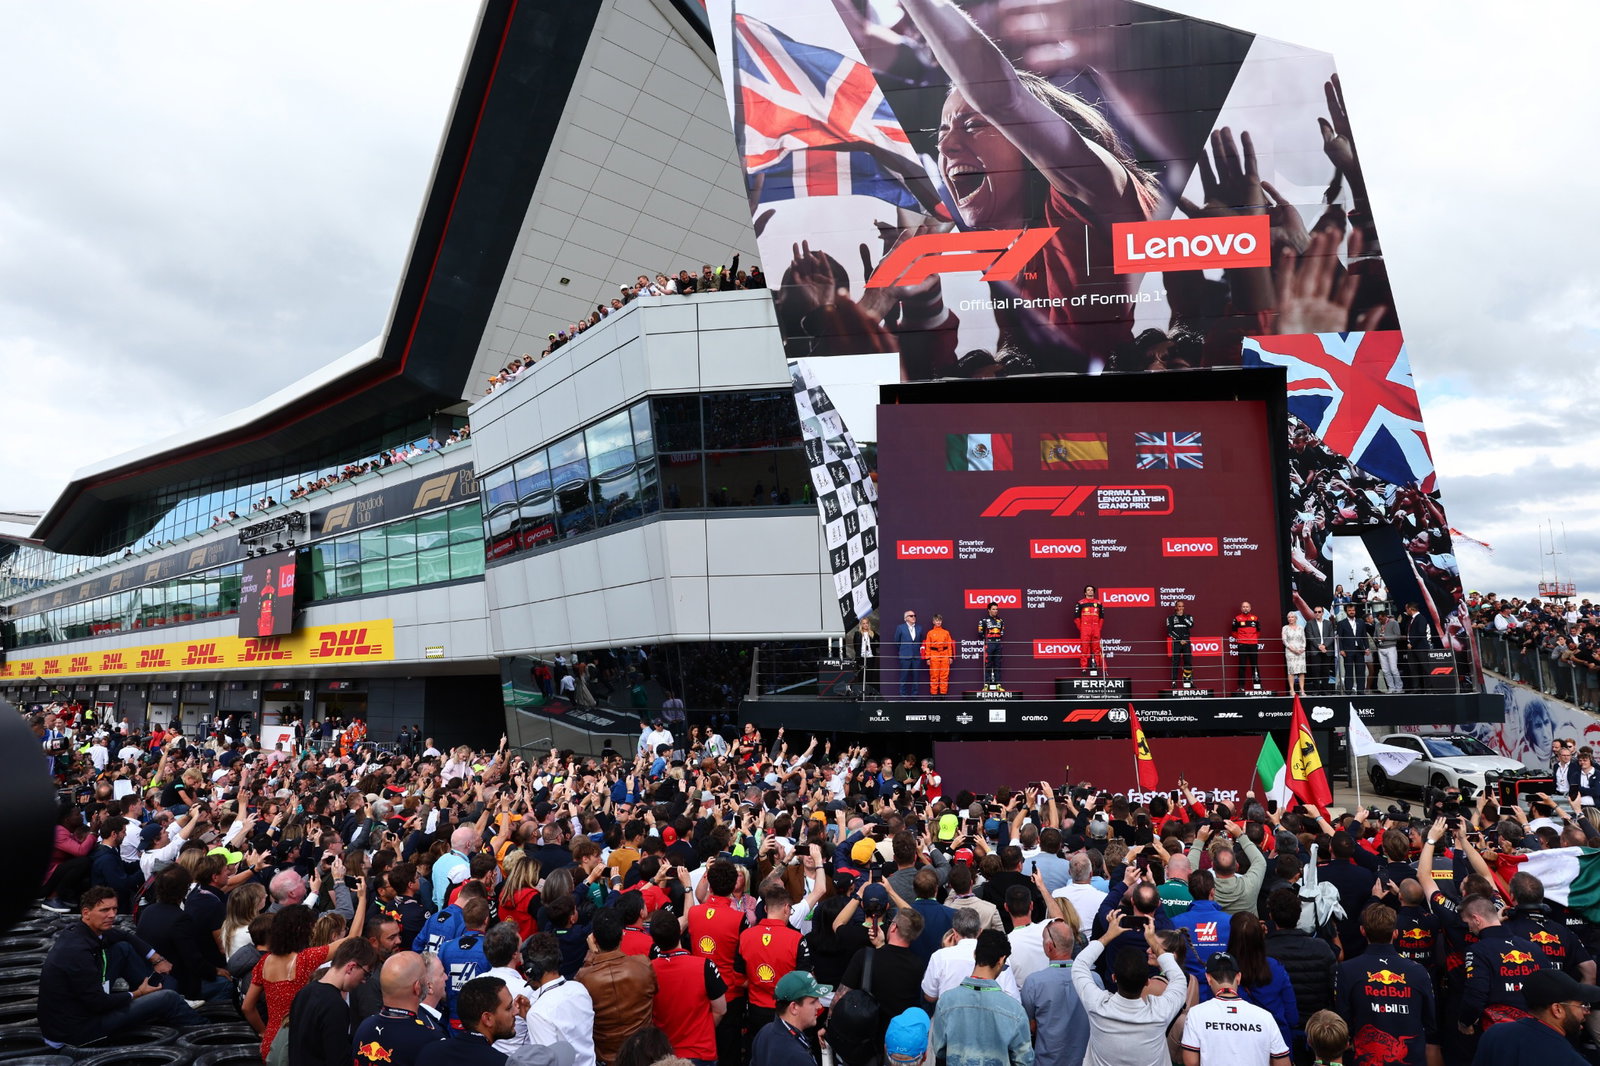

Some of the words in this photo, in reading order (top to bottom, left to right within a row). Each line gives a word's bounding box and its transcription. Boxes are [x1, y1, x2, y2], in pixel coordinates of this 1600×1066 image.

[1126, 232, 1257, 261] Lenovo
[960, 298, 1009, 311] Official
[1013, 297, 1067, 309] Partner
[1071, 294, 1087, 306] of
[1090, 291, 1150, 305] Formula
[1097, 489, 1140, 497] FORMULA
[356, 494, 384, 513] Paddock
[356, 510, 371, 524] Club
[901, 544, 948, 555] Lenovo
[959, 546, 994, 554] technology
[1034, 543, 1082, 554] Lenovo
[1166, 541, 1213, 552] Lenovo
[1223, 543, 1258, 551] technology
[969, 593, 1017, 604] Lenovo
[1027, 595, 1063, 603] technology
[1103, 592, 1150, 603] Lenovo
[318, 629, 371, 657] DHL
[1191, 643, 1219, 651] novo
[186, 643, 218, 664] DHL
[245, 637, 284, 662] DHL
[72, 657, 89, 671] DHL
[103, 653, 124, 669] DHL
[140, 649, 166, 667] DHL
[44, 660, 60, 674] DHL
[1073, 680, 1124, 688] FERRARI
[1109, 709, 1127, 721] FIA
[1191, 787, 1240, 802] fater.
[1365, 985, 1387, 997] Red
[1389, 986, 1411, 998] Bull
[1371, 1002, 1398, 1014] Mobil
[1205, 1021, 1262, 1032] PETRONAS
